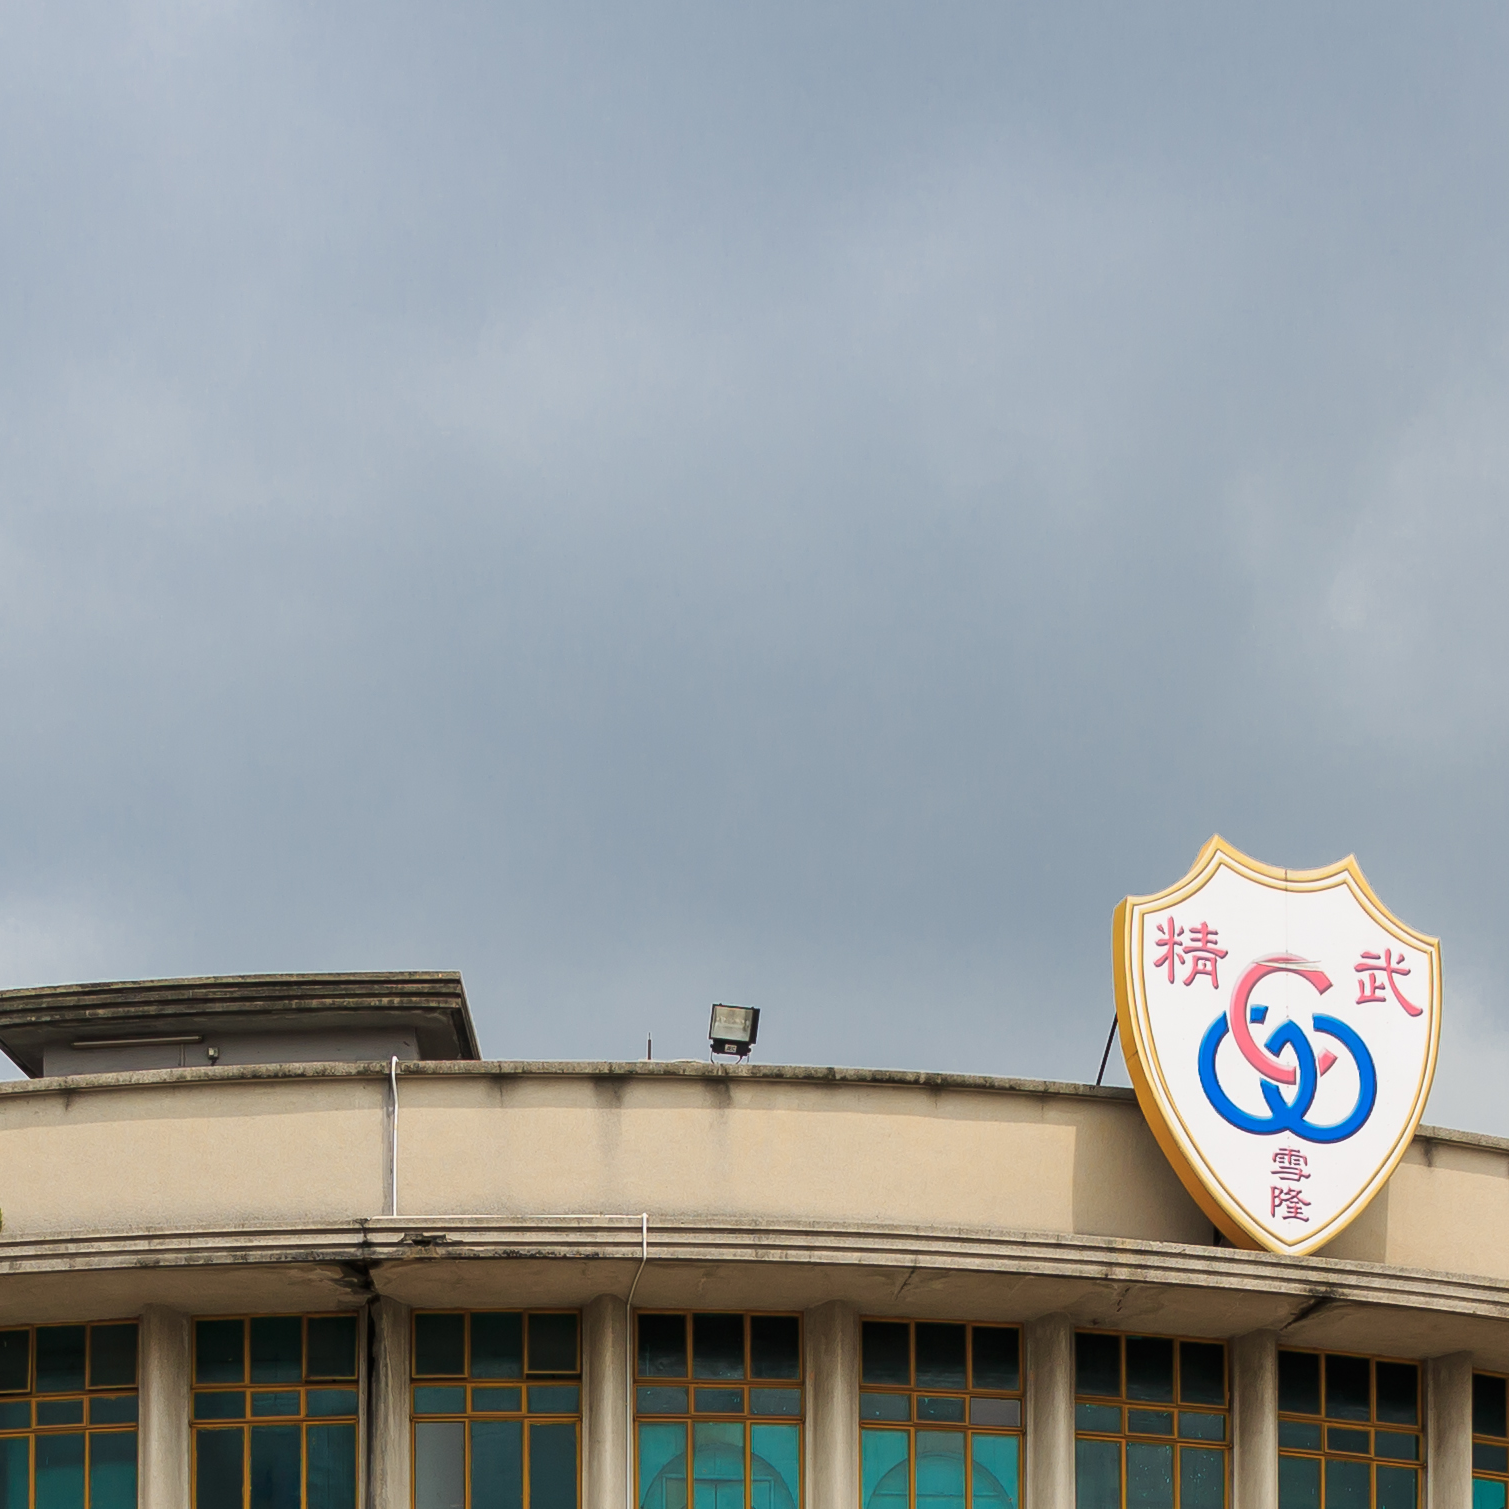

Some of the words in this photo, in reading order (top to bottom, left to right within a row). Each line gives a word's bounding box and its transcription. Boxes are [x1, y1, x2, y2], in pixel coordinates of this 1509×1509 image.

[1154, 915, 1229, 990] 精
[1354, 947, 1423, 1017] 武
[1269, 1147, 1312, 1223] 雪隆
